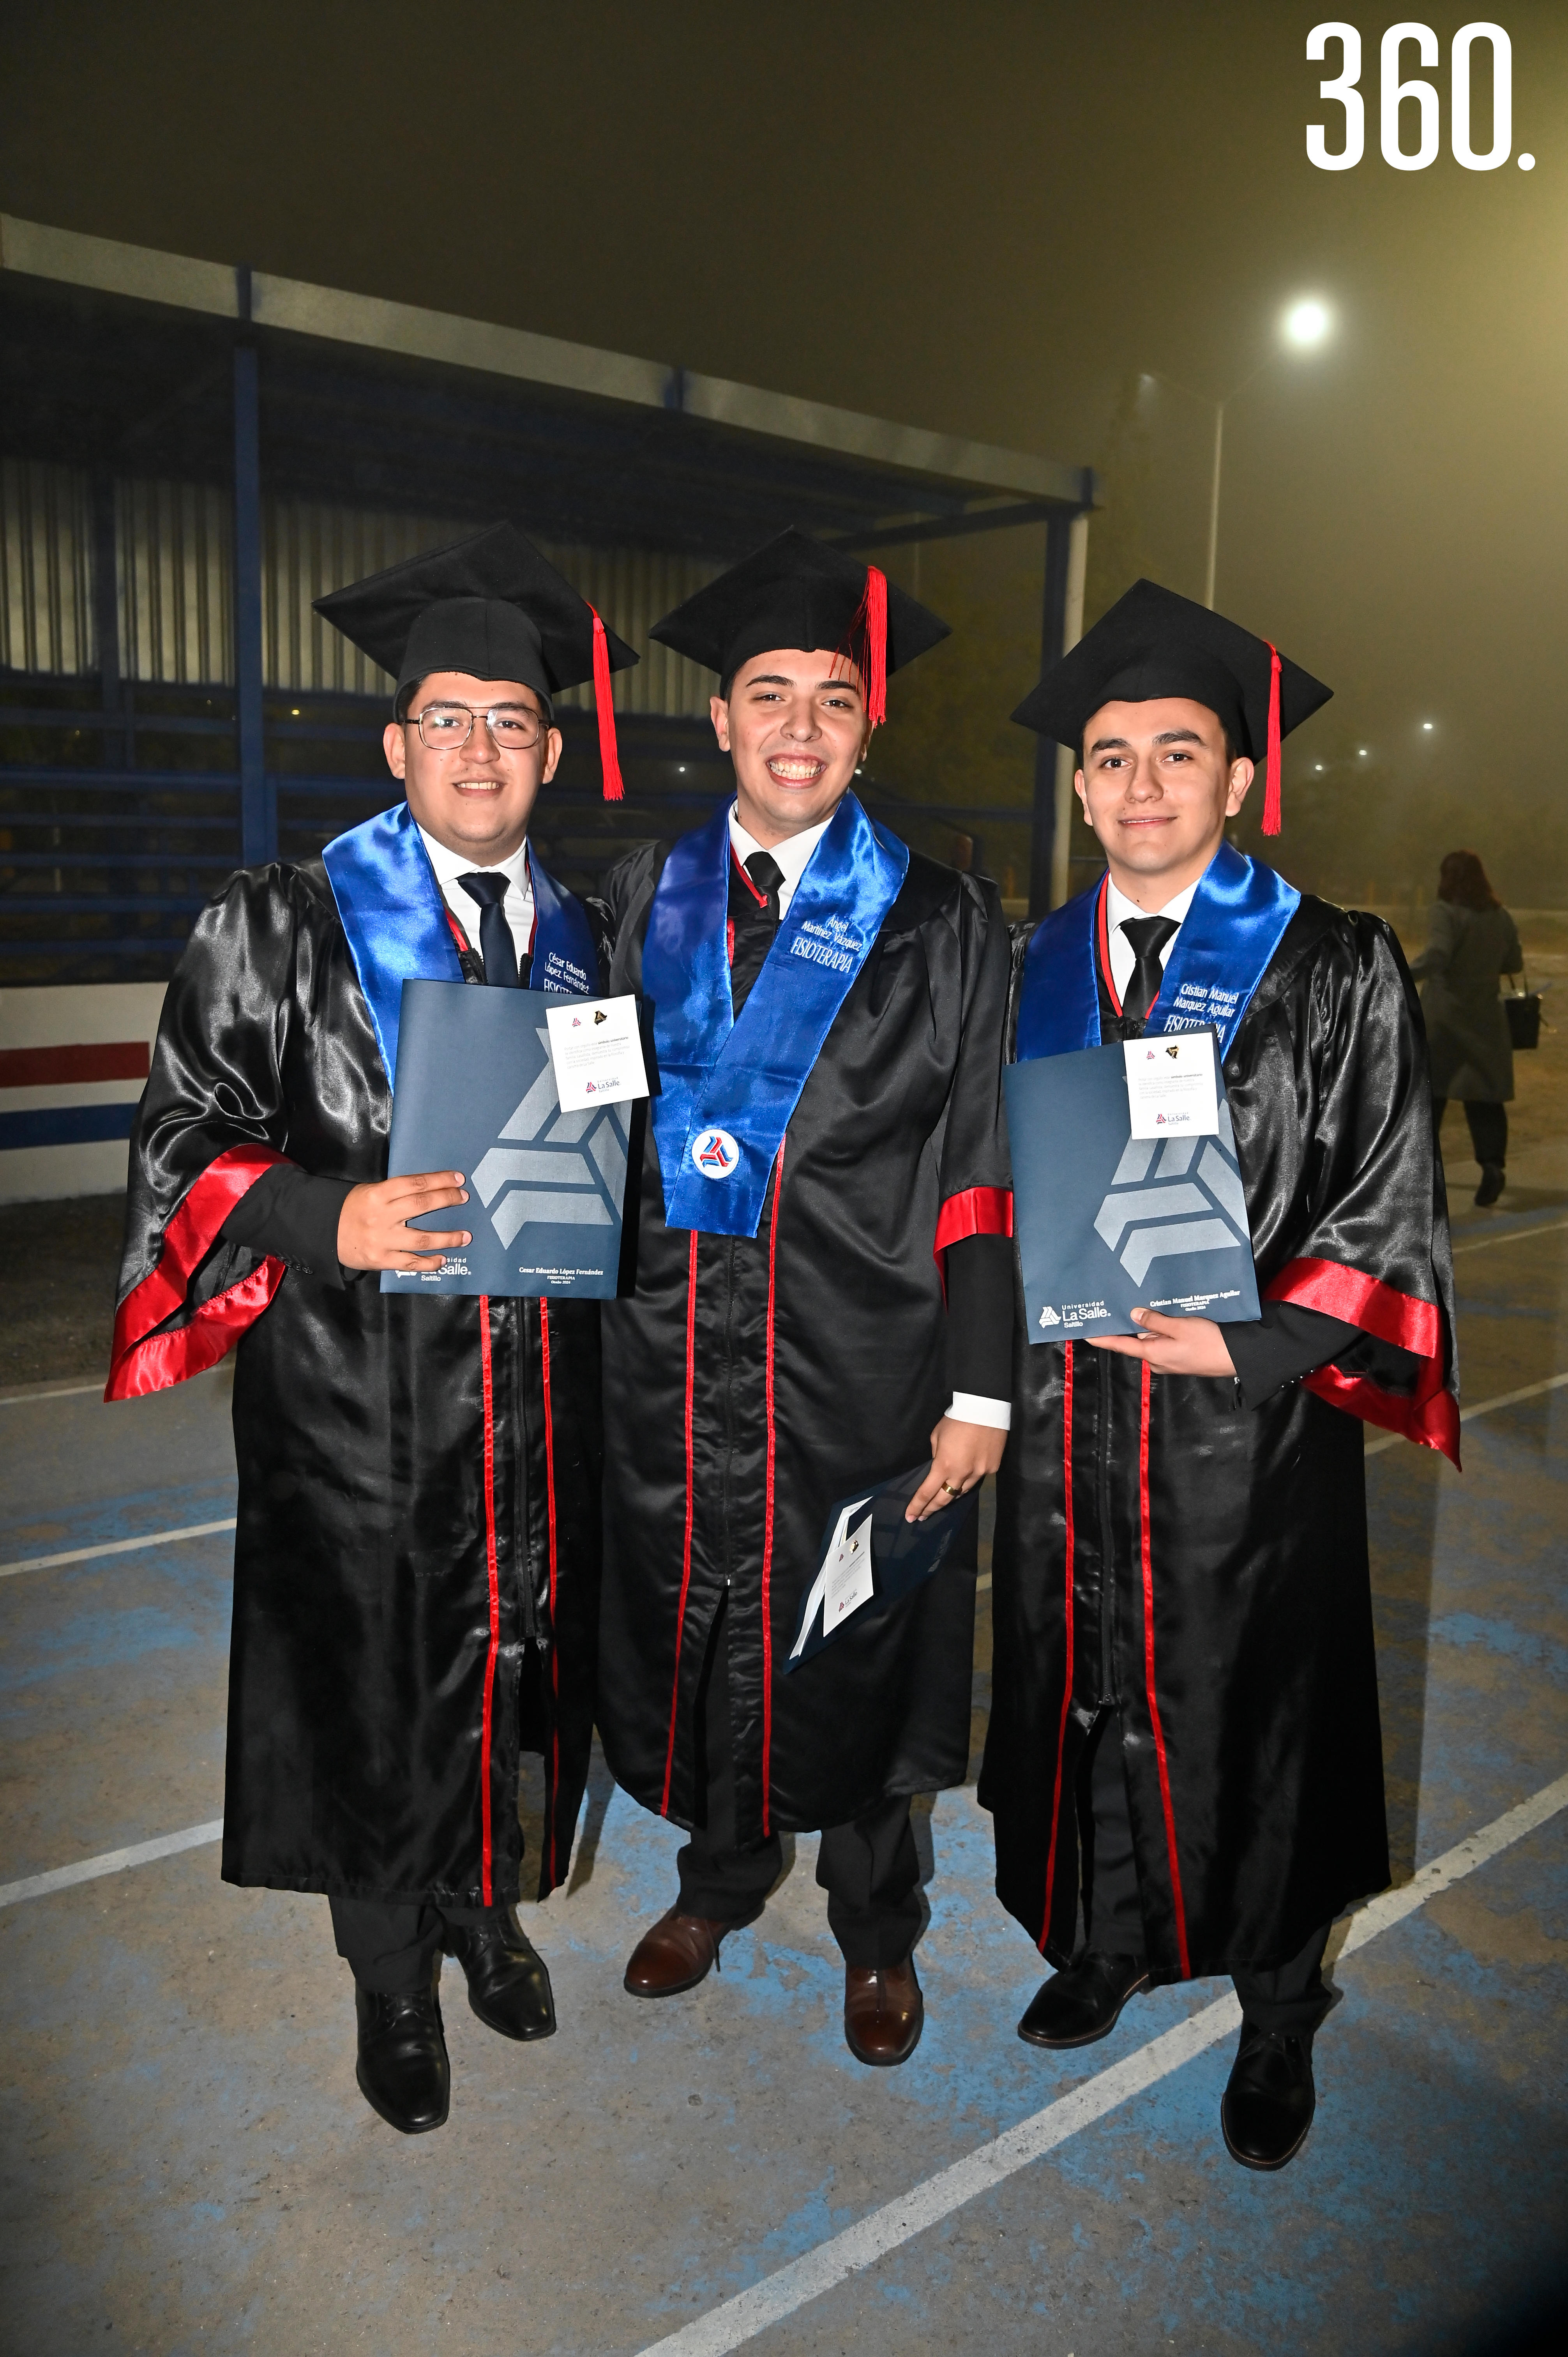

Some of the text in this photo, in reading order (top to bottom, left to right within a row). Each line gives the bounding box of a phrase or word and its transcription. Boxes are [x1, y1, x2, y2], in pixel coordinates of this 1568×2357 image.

[834, 932, 862, 952] Vázquez
[790, 937, 853, 973] FISIOTERAPIA
[549, 952, 586, 980] César Eduardo
[544, 961, 563, 979] López
[563, 971, 589, 995] Fernández
[1181, 984, 1239, 1004] Cristian Manuel
[1173, 997, 1236, 1017] Marquez Aguilar
[1061, 1300, 1104, 1310] Universidad
[1150, 1299, 1172, 1307] Cristian
[1172, 1296, 1193, 1304] Manuel
[1220, 1290, 1240, 1299] Aguilar
[1062, 1310, 1078, 1322] La
